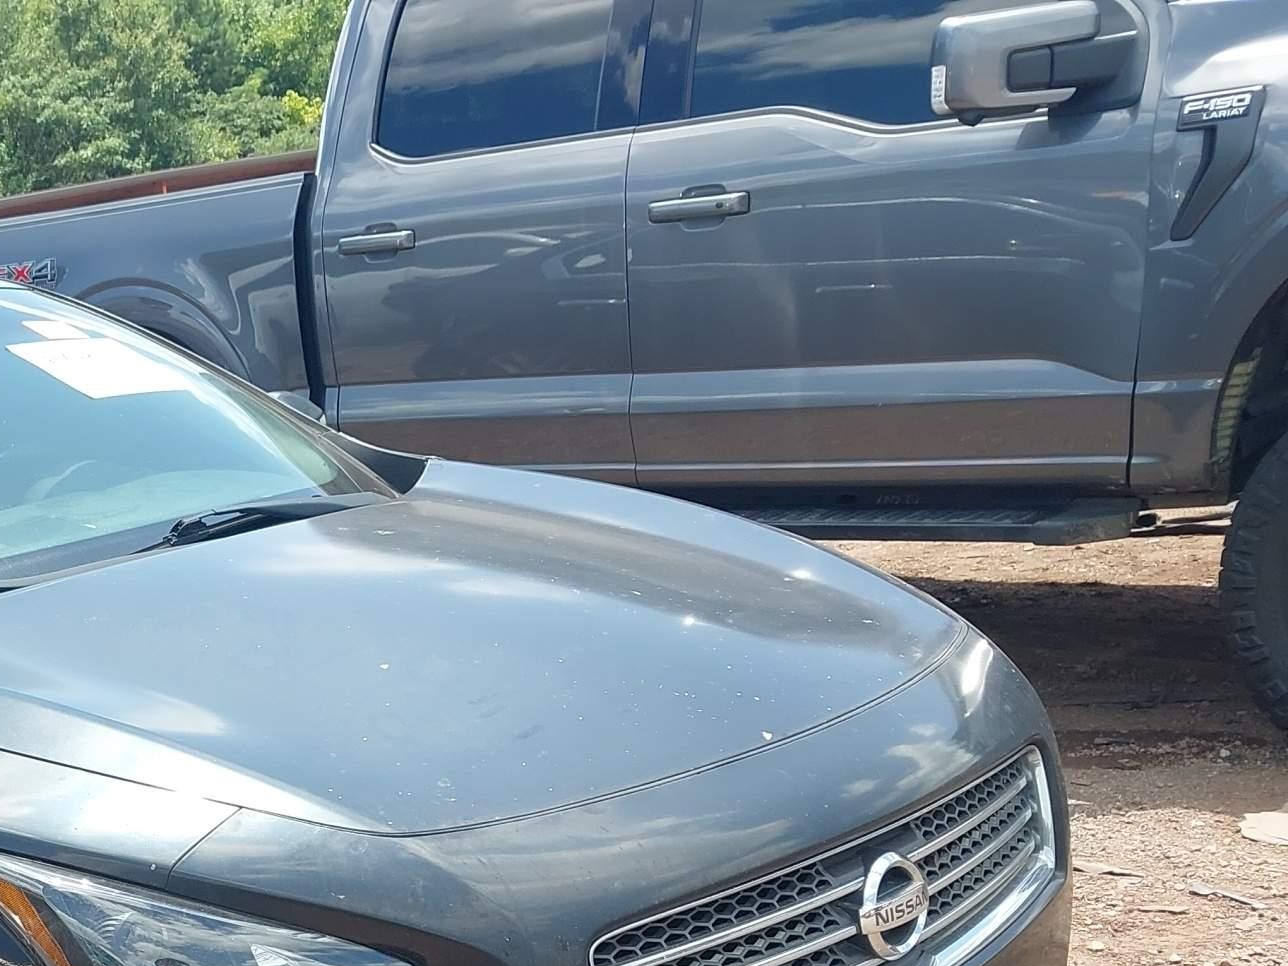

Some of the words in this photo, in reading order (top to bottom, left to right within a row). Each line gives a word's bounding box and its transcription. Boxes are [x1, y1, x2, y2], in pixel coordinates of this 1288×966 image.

[1184, 93, 1252, 114] F-150
[1202, 106, 1248, 120] LARIAT
[874, 890, 928, 927] NISSAN
